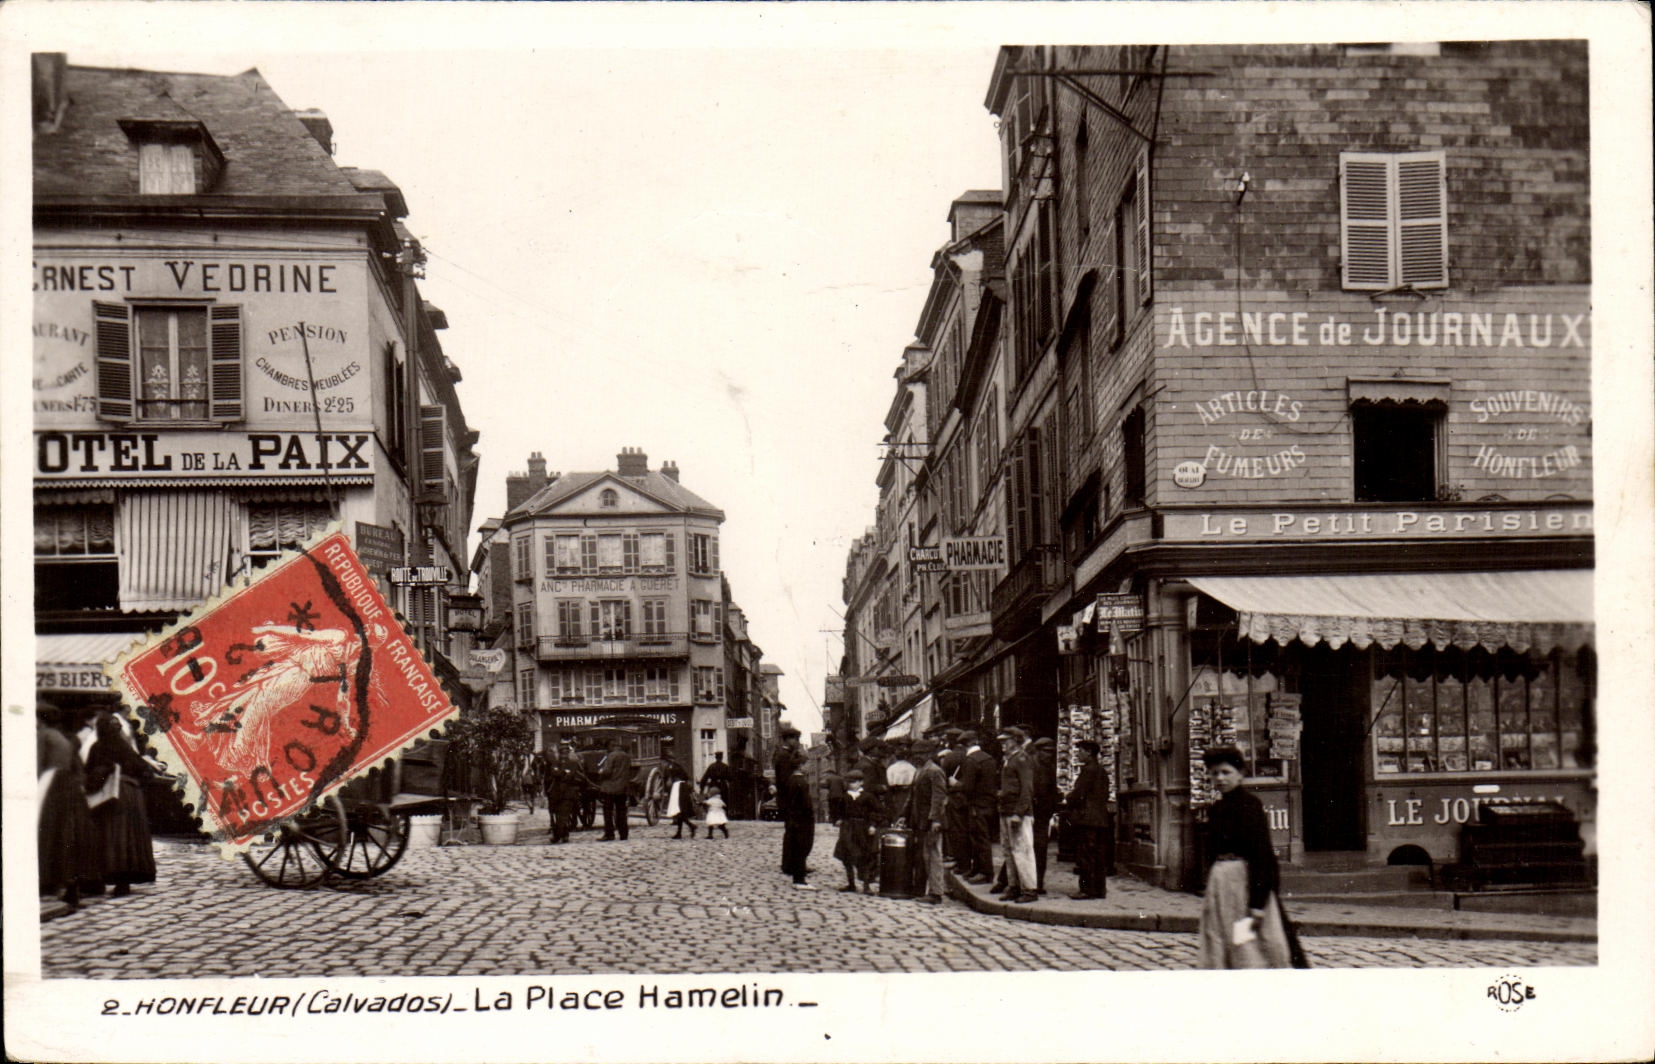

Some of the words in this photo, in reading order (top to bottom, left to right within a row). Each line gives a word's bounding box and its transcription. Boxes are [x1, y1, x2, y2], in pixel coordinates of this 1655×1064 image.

[164, 260, 338, 294] VEDRINE
[268, 324, 348, 345] PENSION
[1163, 306, 1309, 350] AGENCE
[1318, 315, 1352, 345] de
[1362, 306, 1586, 348] JOURNAUX
[255, 357, 309, 391] CHAMBRES
[1195, 389, 1304, 428] ARTICLES
[1469, 389, 1584, 427] SOUVENIRS
[1239, 428, 1264, 441] DE
[1516, 428, 1539, 441] DE
[181, 452, 207, 471] DE
[212, 452, 242, 471] LA
[248, 433, 370, 471] PAIX
[1201, 444, 1307, 479] FUMEURS
[1471, 442, 1582, 479] HONFLEUR
[1200, 513, 1248, 536] Le
[1272, 511, 1373, 535] Petit
[1395, 509, 1593, 534] Parisien
[945, 540, 1005, 566] PHARMACIE
[324, 543, 382, 622] REPUBLIQUE
[571, 580, 625, 593] PHARMACIE
[387, 638, 442, 714] FRANÇAISE
[238, 771, 315, 825] POSTES
[1387, 798, 1424, 826] LE
